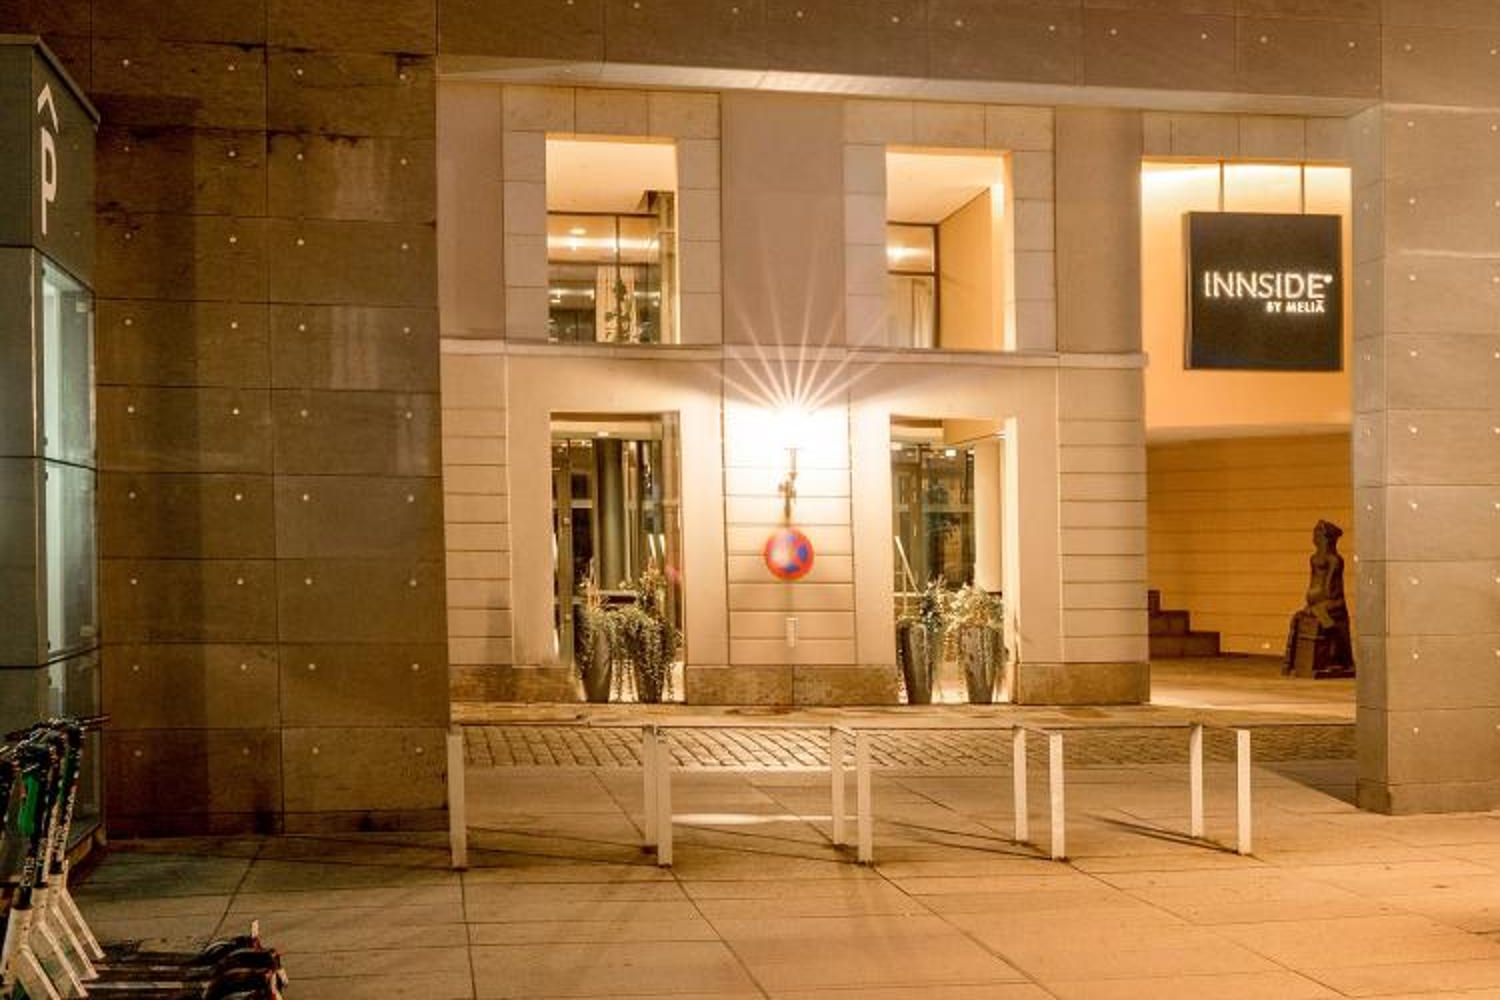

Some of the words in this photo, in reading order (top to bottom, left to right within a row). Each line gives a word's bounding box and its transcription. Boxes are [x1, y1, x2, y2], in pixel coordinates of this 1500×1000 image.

[41, 126, 57, 236] P
[1204, 271, 1326, 299] INNSIDE
[1266, 301, 1283, 313] BY
